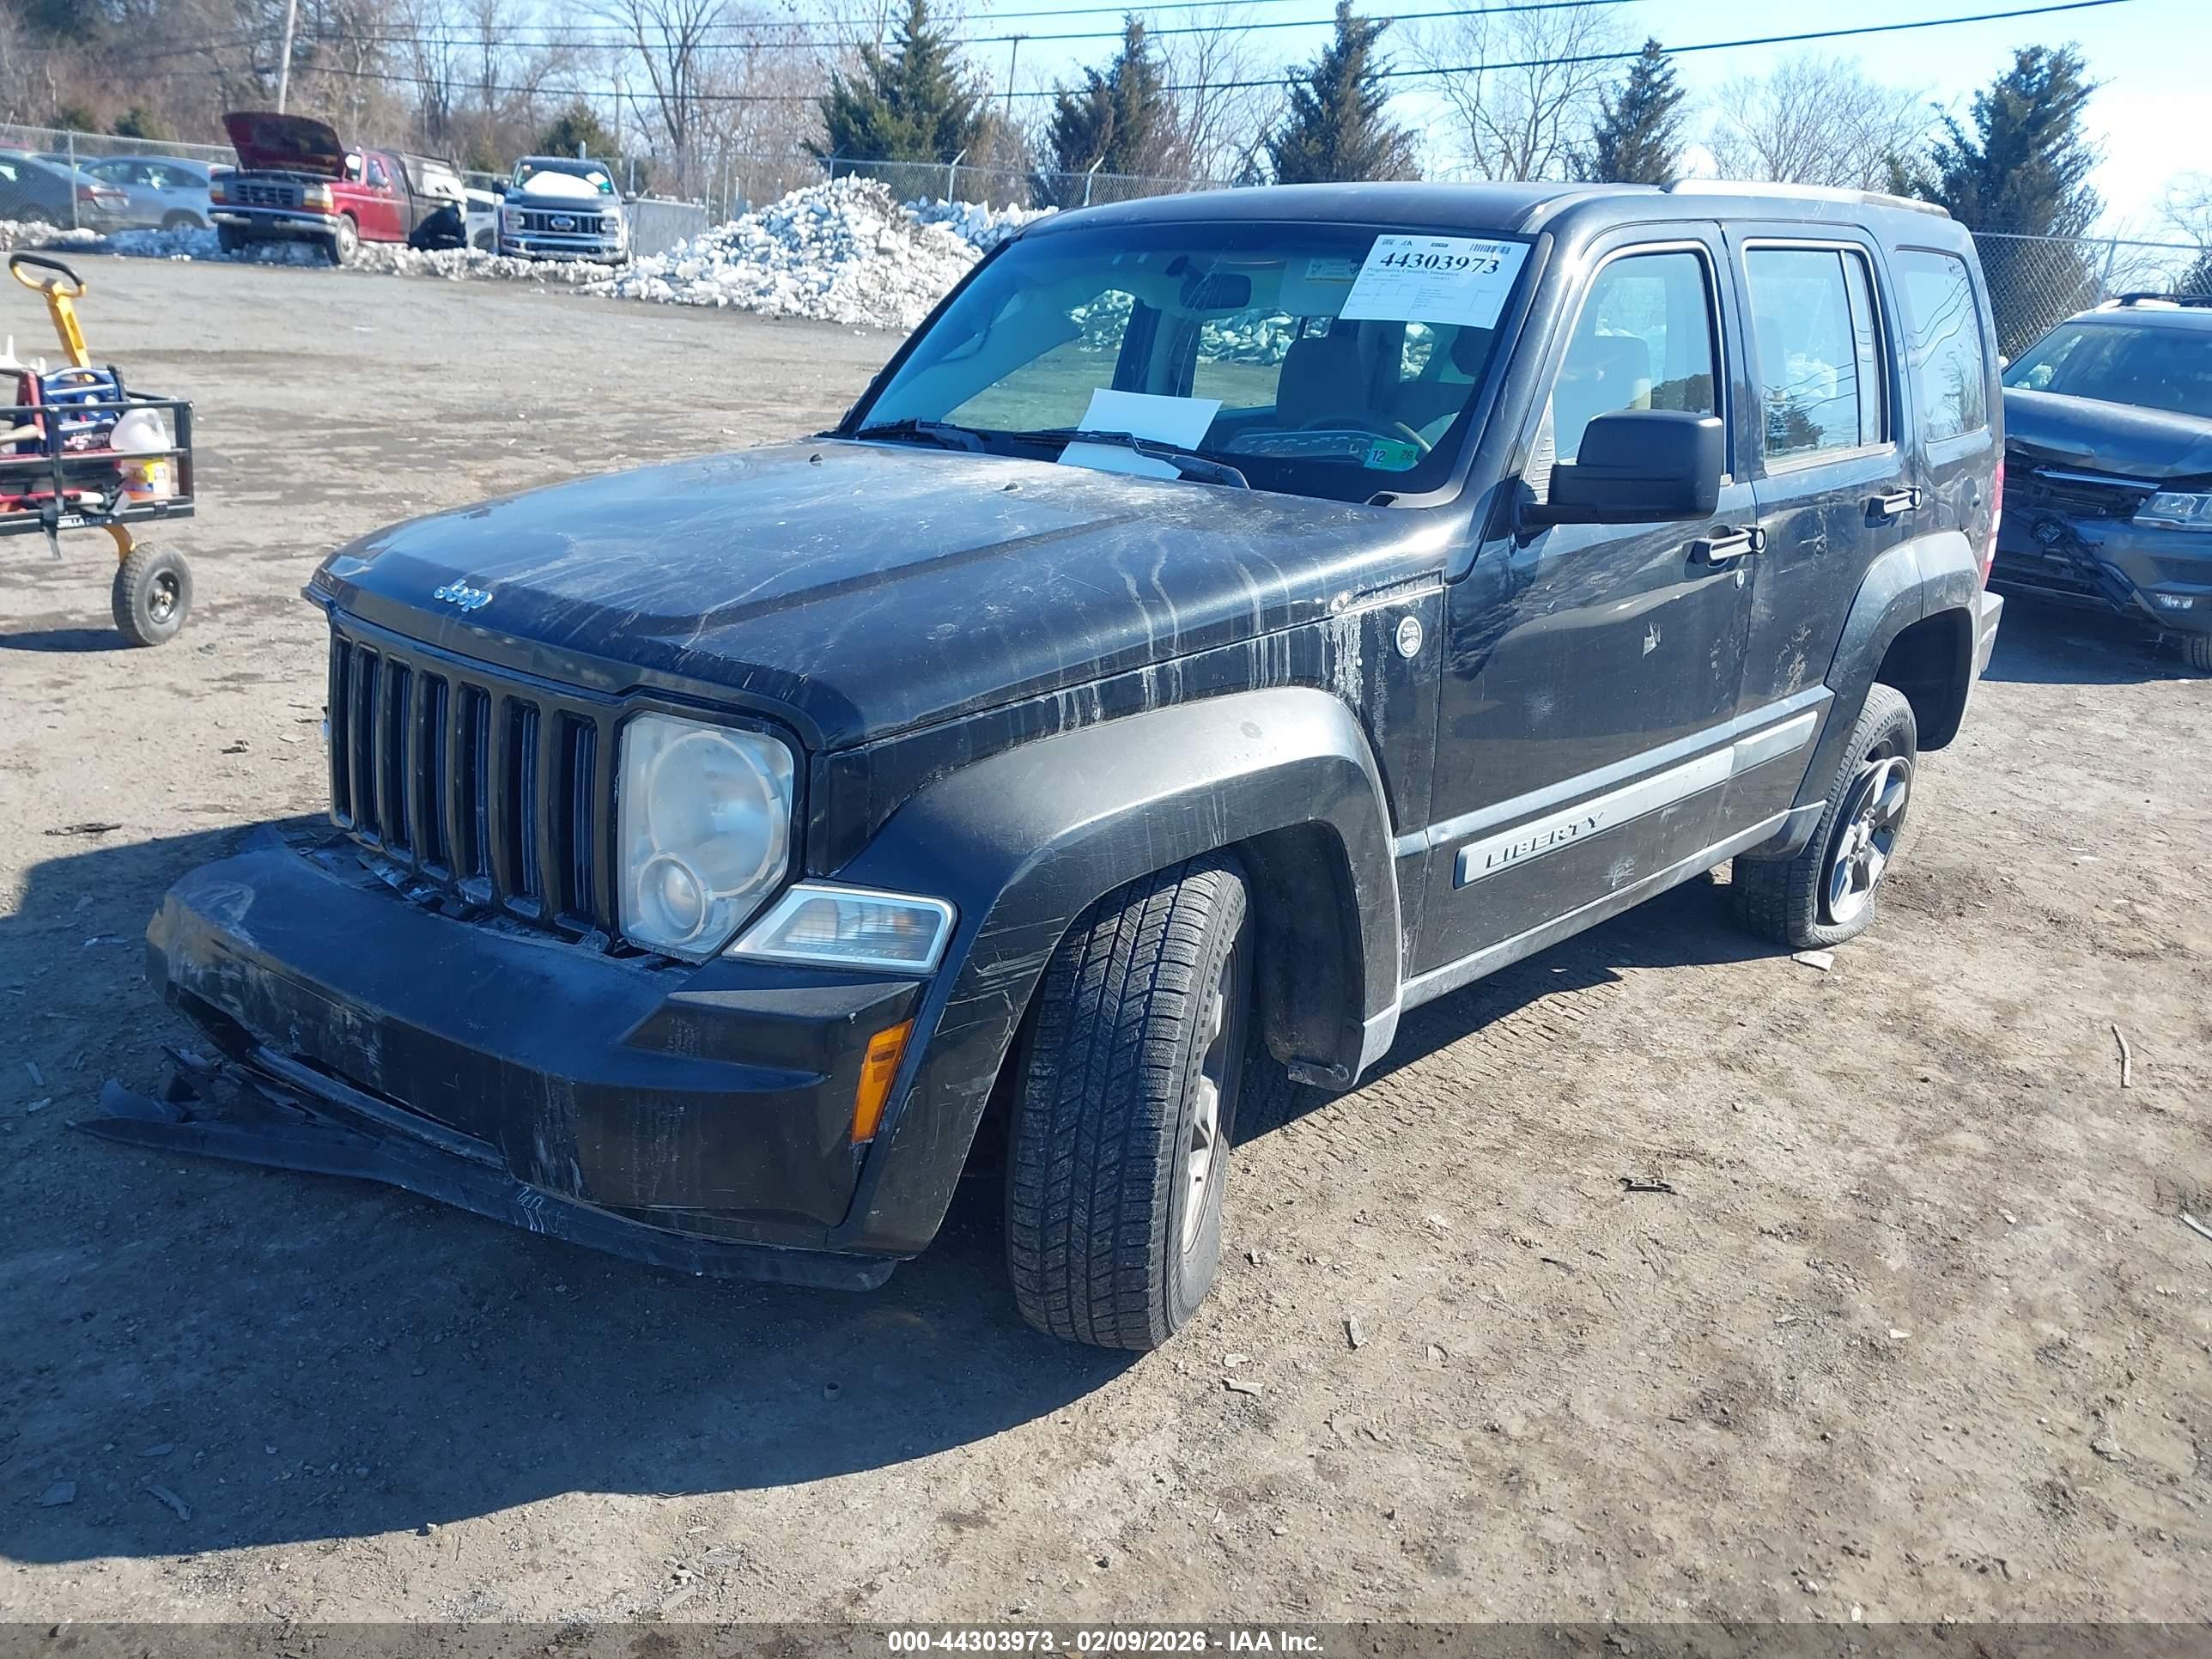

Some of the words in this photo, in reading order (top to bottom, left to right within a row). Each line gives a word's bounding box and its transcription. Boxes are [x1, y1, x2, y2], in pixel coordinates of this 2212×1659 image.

[1380, 252, 1500, 275] 44303973
[1372, 449, 1387, 463] 12
[1486, 810, 1607, 869] LIBERTY
